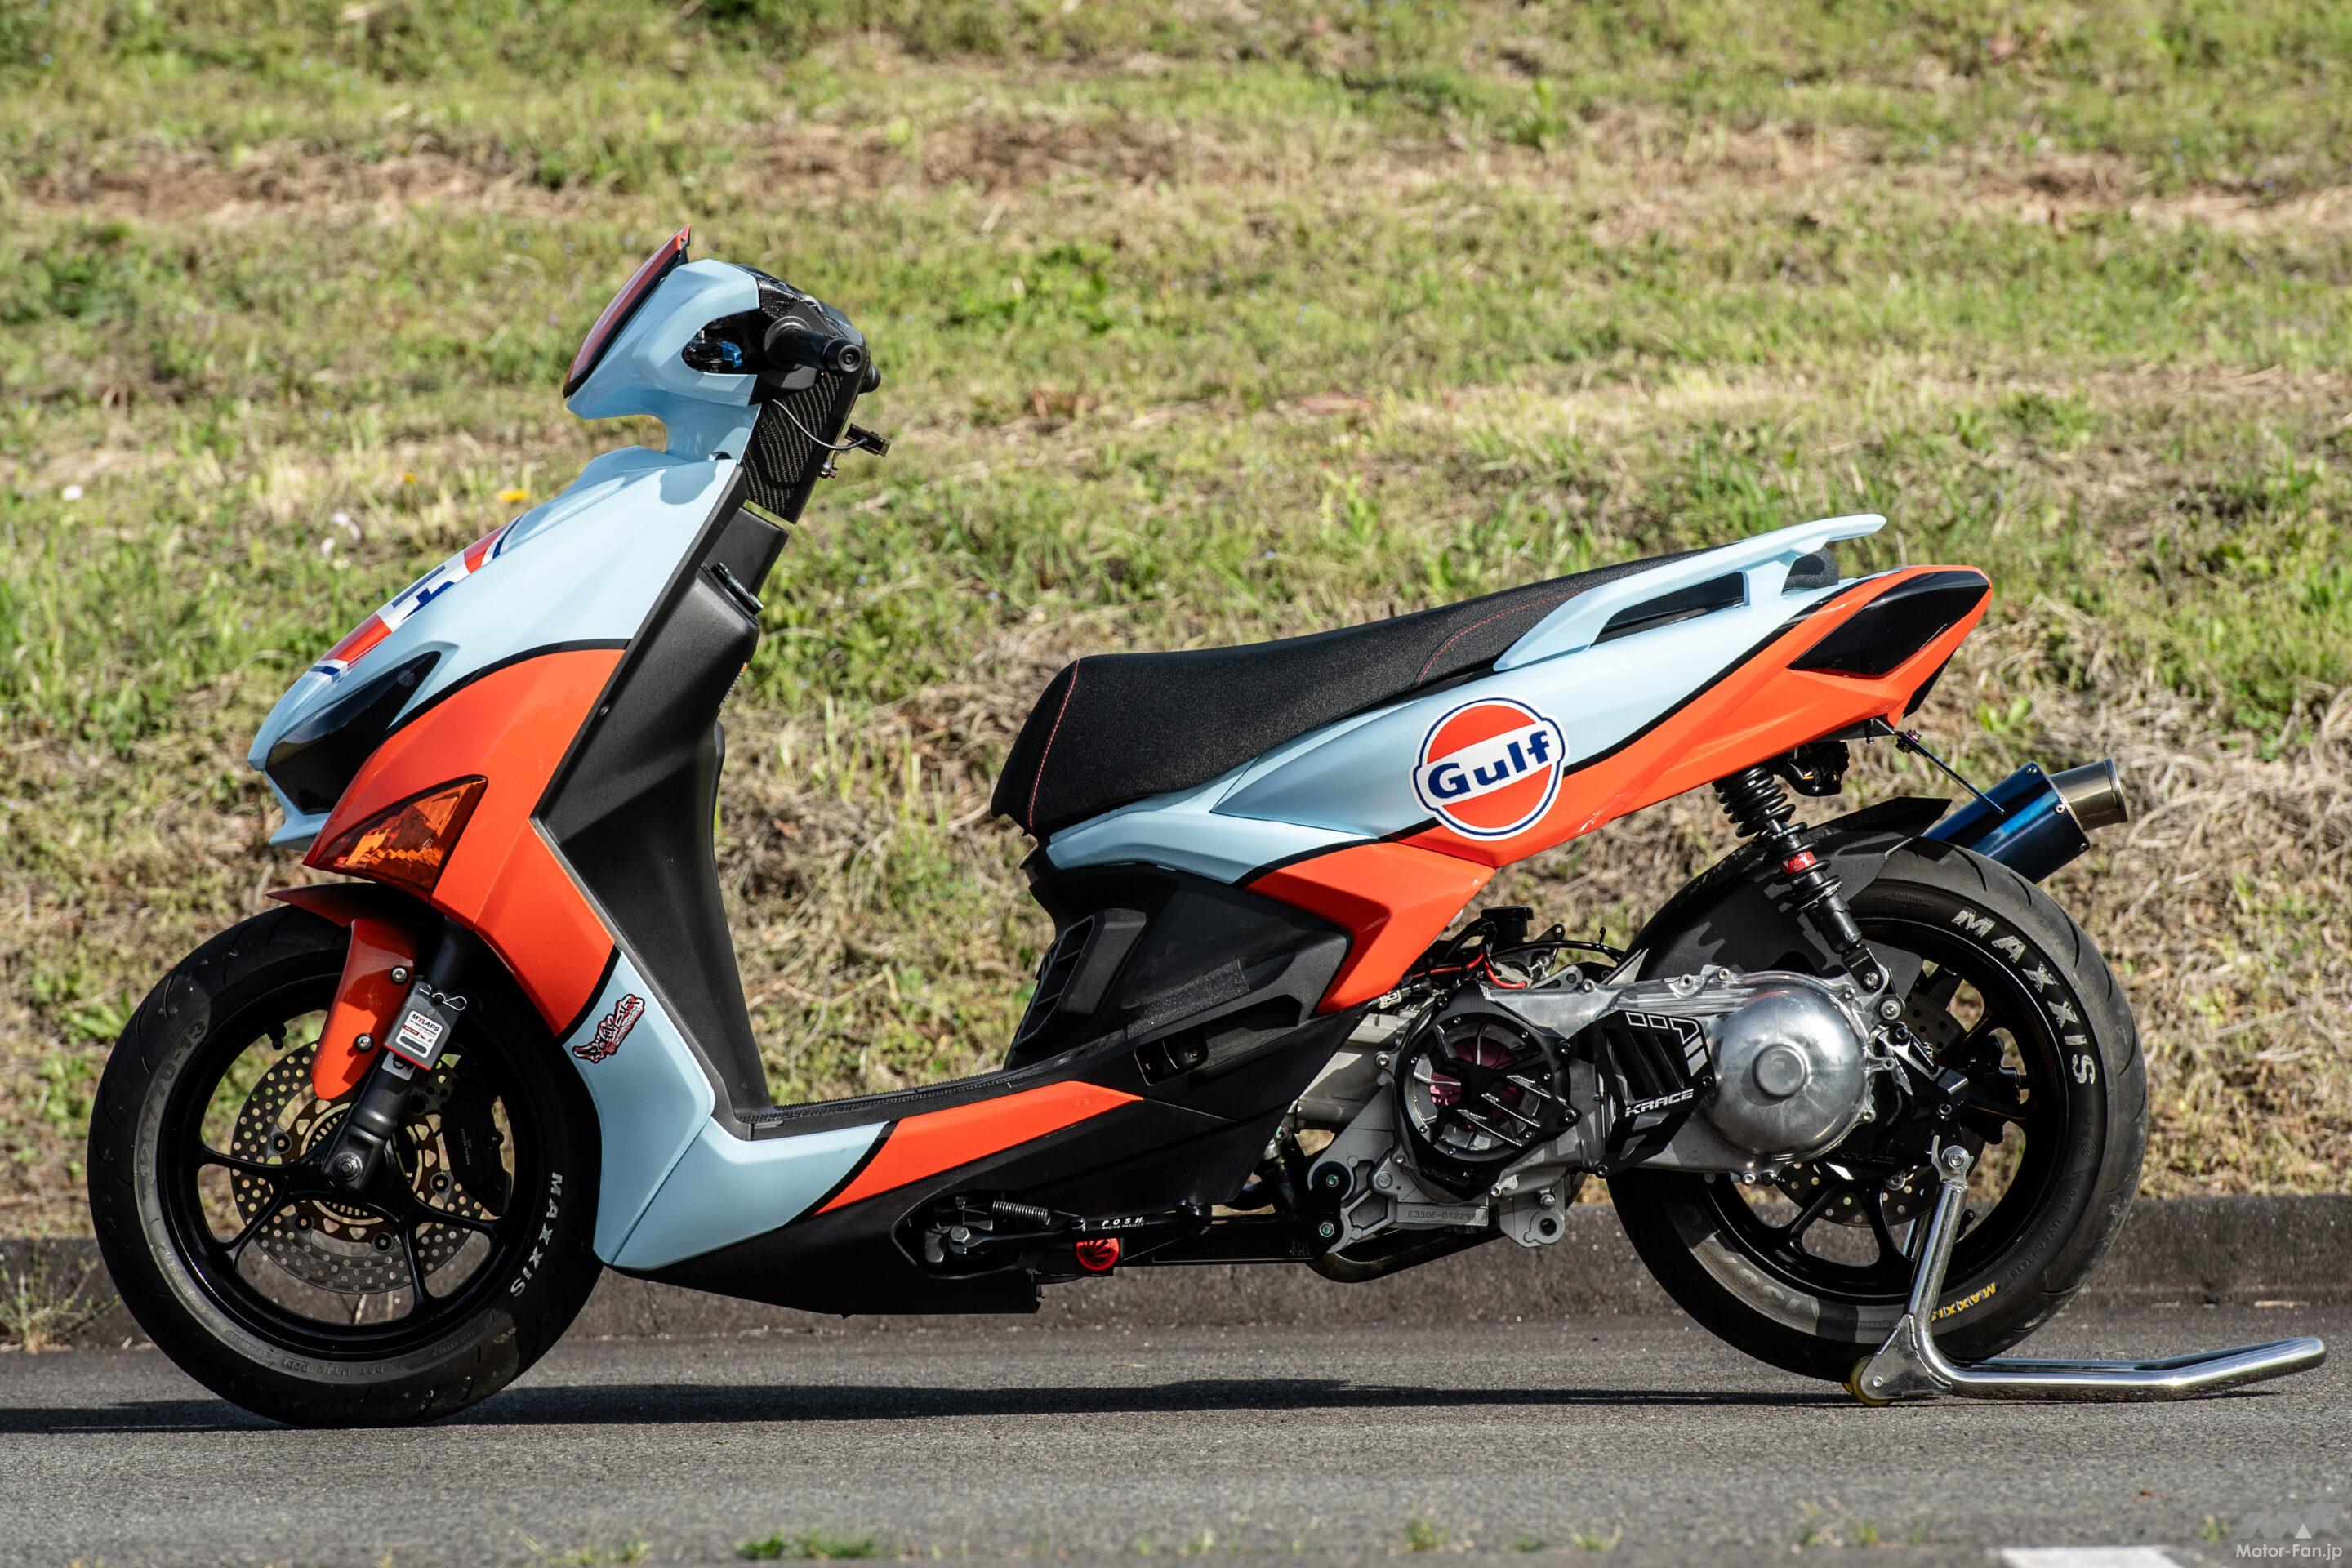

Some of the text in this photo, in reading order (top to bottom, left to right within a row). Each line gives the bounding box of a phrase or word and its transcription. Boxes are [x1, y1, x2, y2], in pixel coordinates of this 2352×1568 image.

[1428, 730, 1550, 800] Gulf
[412, 1013, 440, 1032] MYLAPS
[1951, 906, 2096, 1085] MAXXIS
[1625, 1089, 1694, 1117] KRACE
[510, 1172, 563, 1297] MAXXIS
